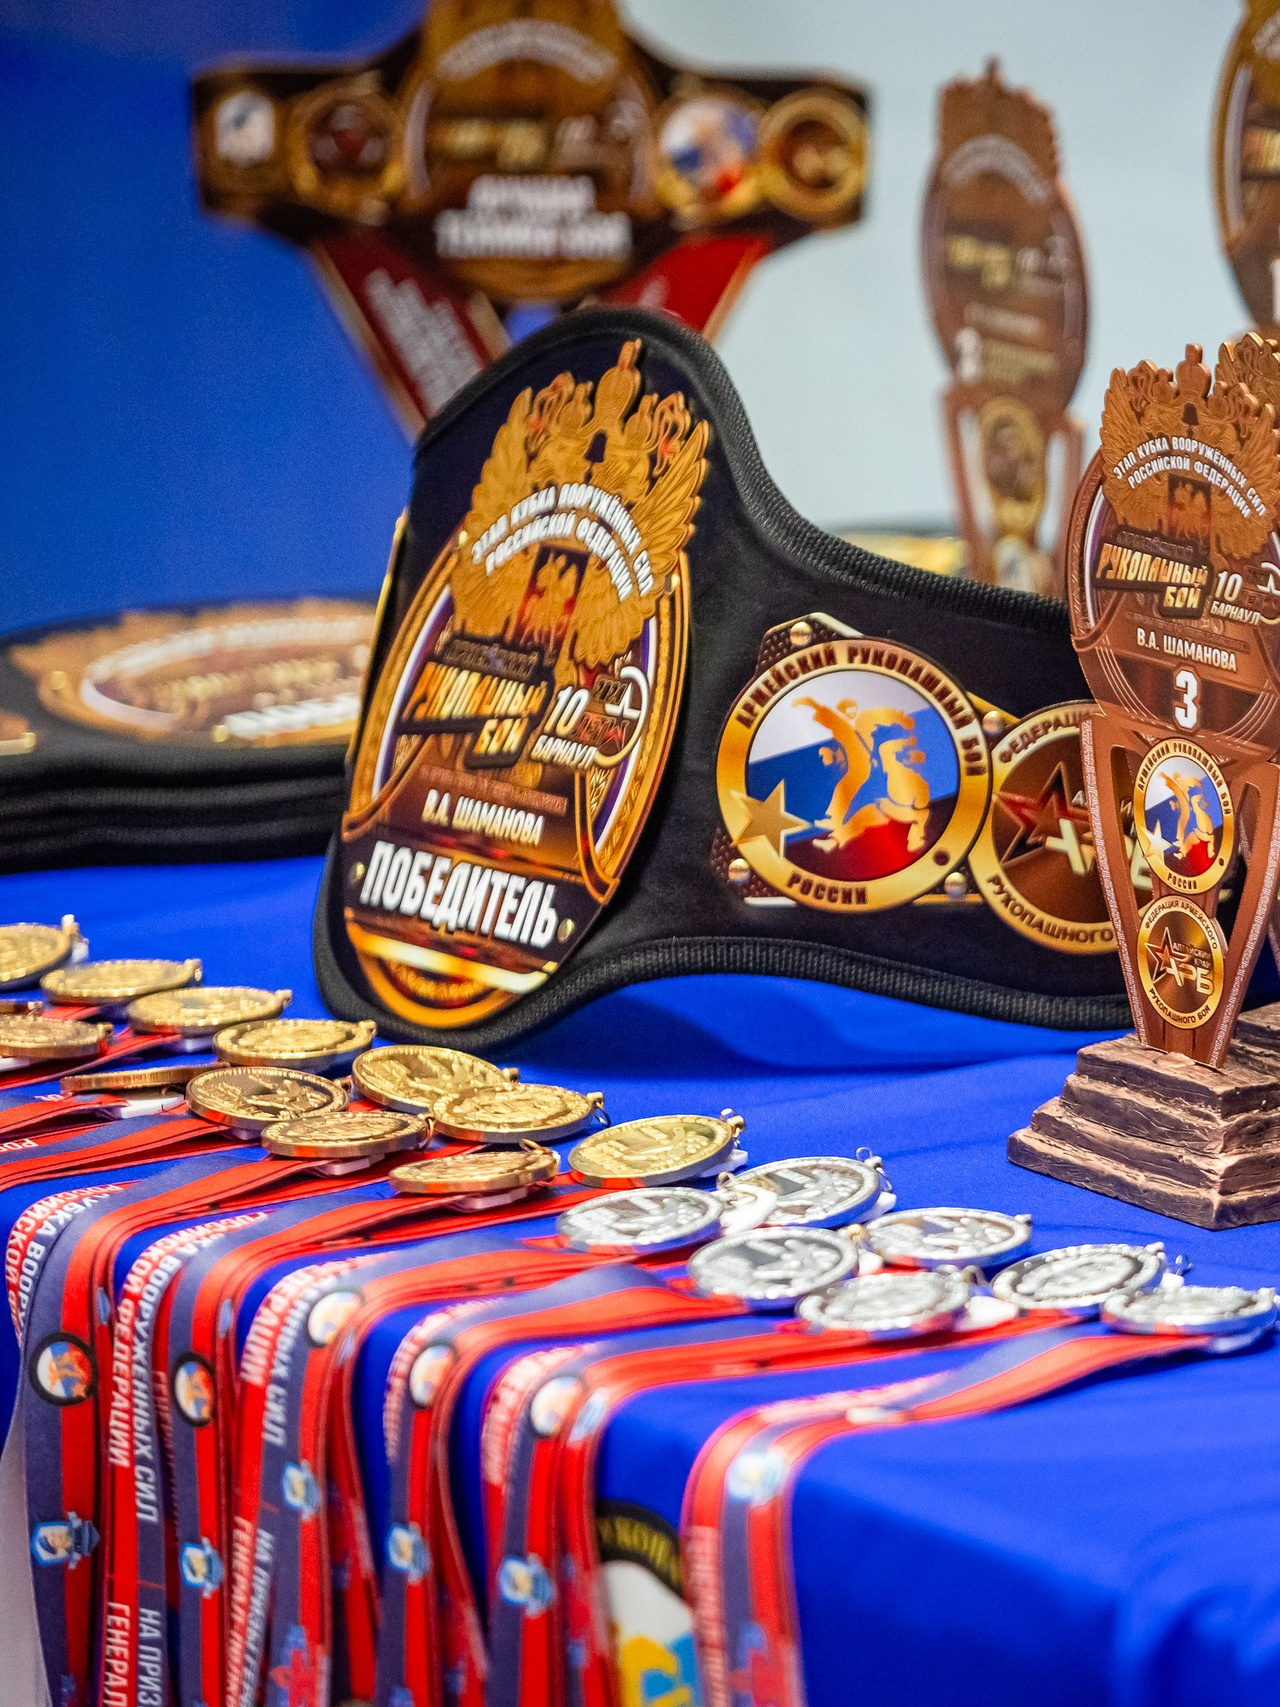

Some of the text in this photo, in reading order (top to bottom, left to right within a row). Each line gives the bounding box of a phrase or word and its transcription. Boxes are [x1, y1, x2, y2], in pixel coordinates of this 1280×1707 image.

[1113, 436, 1267, 517] ЭТАП КУБКА ВООРУЖЁННЫХ СИЛ
[1127, 456, 1252, 518] РОССИЙСКОЙ ФЕДЕРАЦИИ
[1096, 543, 1209, 585] РУКОПАШНЫЙ
[1214, 570, 1242, 601] 10
[1162, 583, 1201, 609] БОЙ
[1210, 601, 1262, 625] БАРНАУЛ
[1137, 628, 1237, 672] В.А. ШАМАНОВА
[543, 686, 590, 736] 10
[735, 642, 989, 778] АРМЕЙСКИЙ РУКОПАШНЫЙ БОЙ
[1173, 669, 1198, 728] 3
[530, 735, 598, 769] БАРНАУЛ
[1137, 742, 1232, 816] АРМЕЙСКИЙ РУКОПАШНЫЙ БОЙ
[421, 789, 450, 826] В.А.
[452, 795, 544, 847] ШАМАНОВА
[359, 840, 559, 949] ПОБЕДИТЕЛЬ
[786, 872, 868, 906] РОССИИ
[1166, 872, 1198, 890] РОССИИ
[986, 874, 1113, 945] РУКОПАШНОГО
[1145, 900, 1218, 949] ФЕДЕРАЦИЯ АРМЕЙСКОГО
[1148, 988, 1211, 1024] РУКОПАШНОГО БОЯ
[5, 1184, 123, 1286] РОССИЙСКОЙ
[108, 1299, 136, 1469] ФЕДЕРАЦИИ
[262, 1384, 288, 1446] СИЛ
[134, 1466, 160, 1523] СИЛ
[138, 1607, 161, 1639] НА
